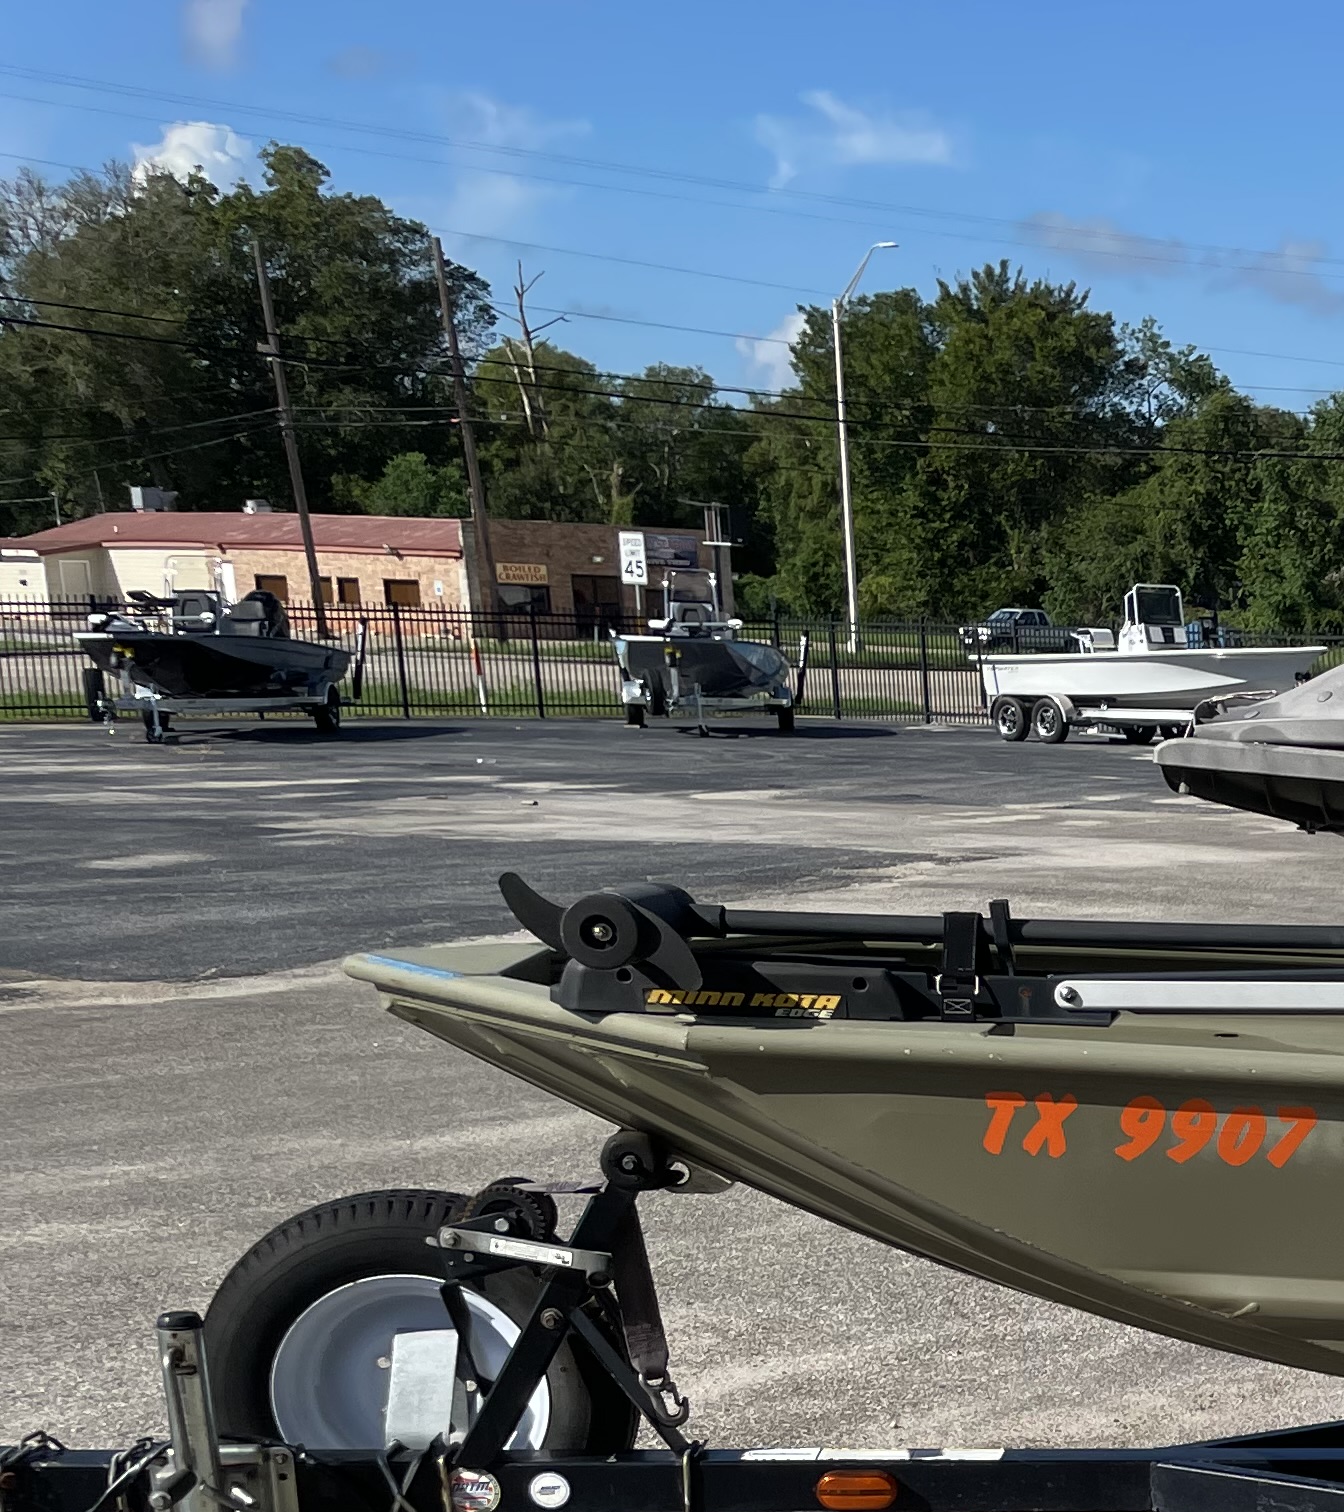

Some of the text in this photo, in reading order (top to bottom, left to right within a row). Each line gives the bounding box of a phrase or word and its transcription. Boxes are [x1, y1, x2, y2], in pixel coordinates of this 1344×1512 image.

[625, 560, 644, 577] 45
[648, 988, 842, 1009] MINN KOTA
[775, 1008, 835, 1019] EDGE
[982, 1090, 1078, 1159] TX
[1114, 1096, 1317, 1169] 9907
